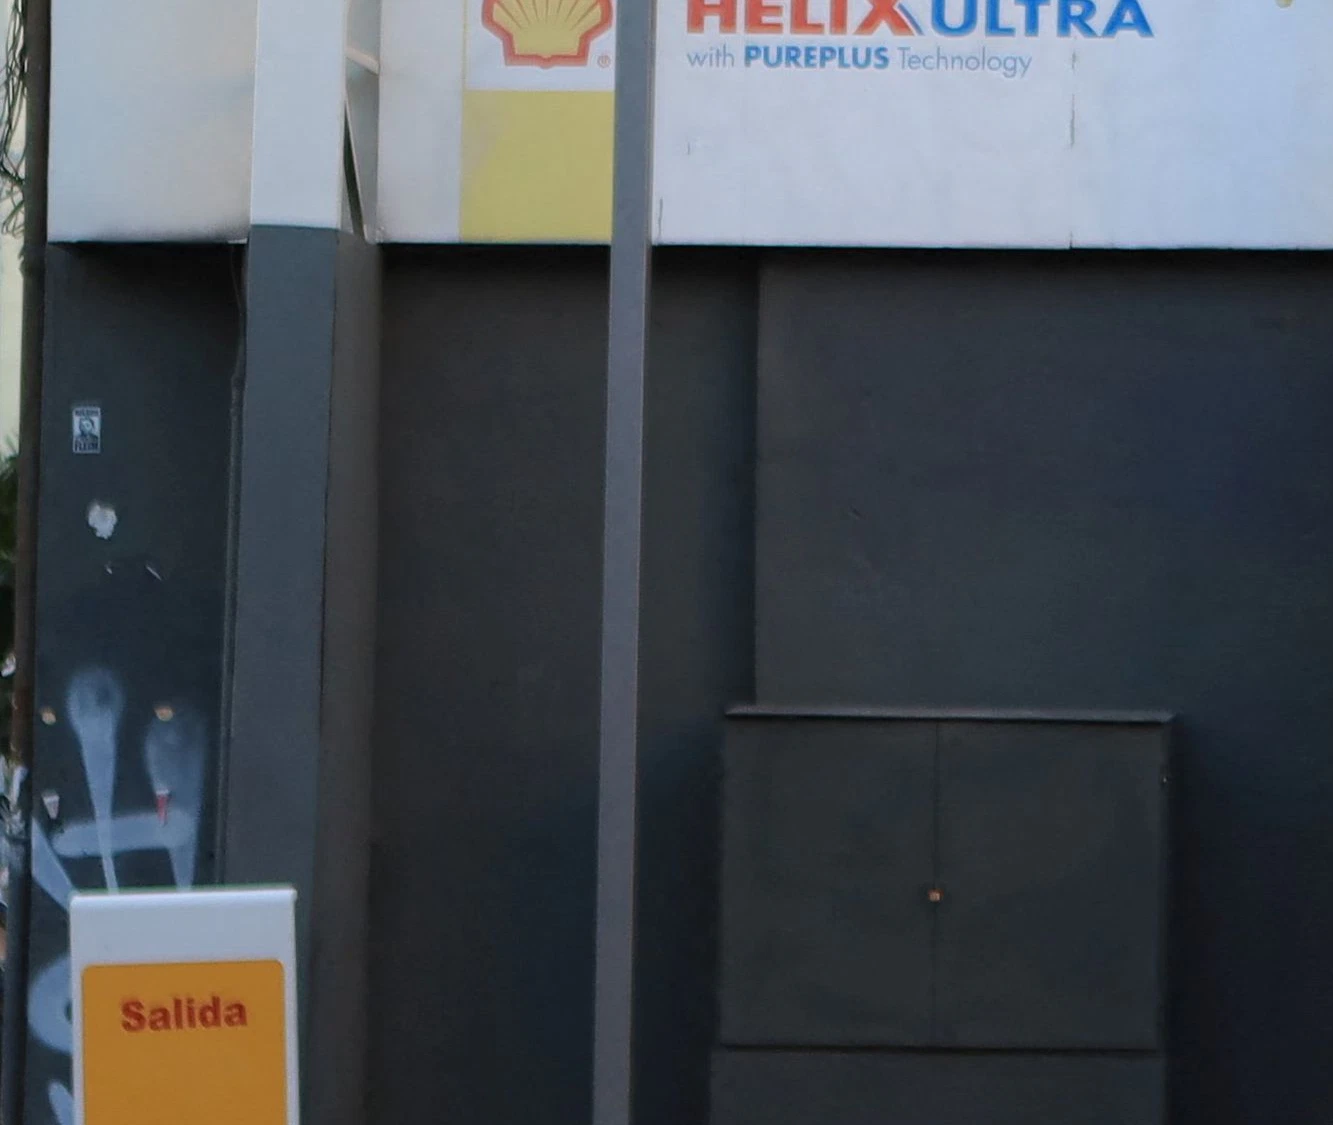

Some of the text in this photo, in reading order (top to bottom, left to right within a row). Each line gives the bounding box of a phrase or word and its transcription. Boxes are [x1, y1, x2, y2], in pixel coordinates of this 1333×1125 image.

[686, 0, 1155, 38] HELIX ULTRA
[686, 43, 1033, 78] with PUREPLUS Technology
[120, 995, 248, 1033] Salida
